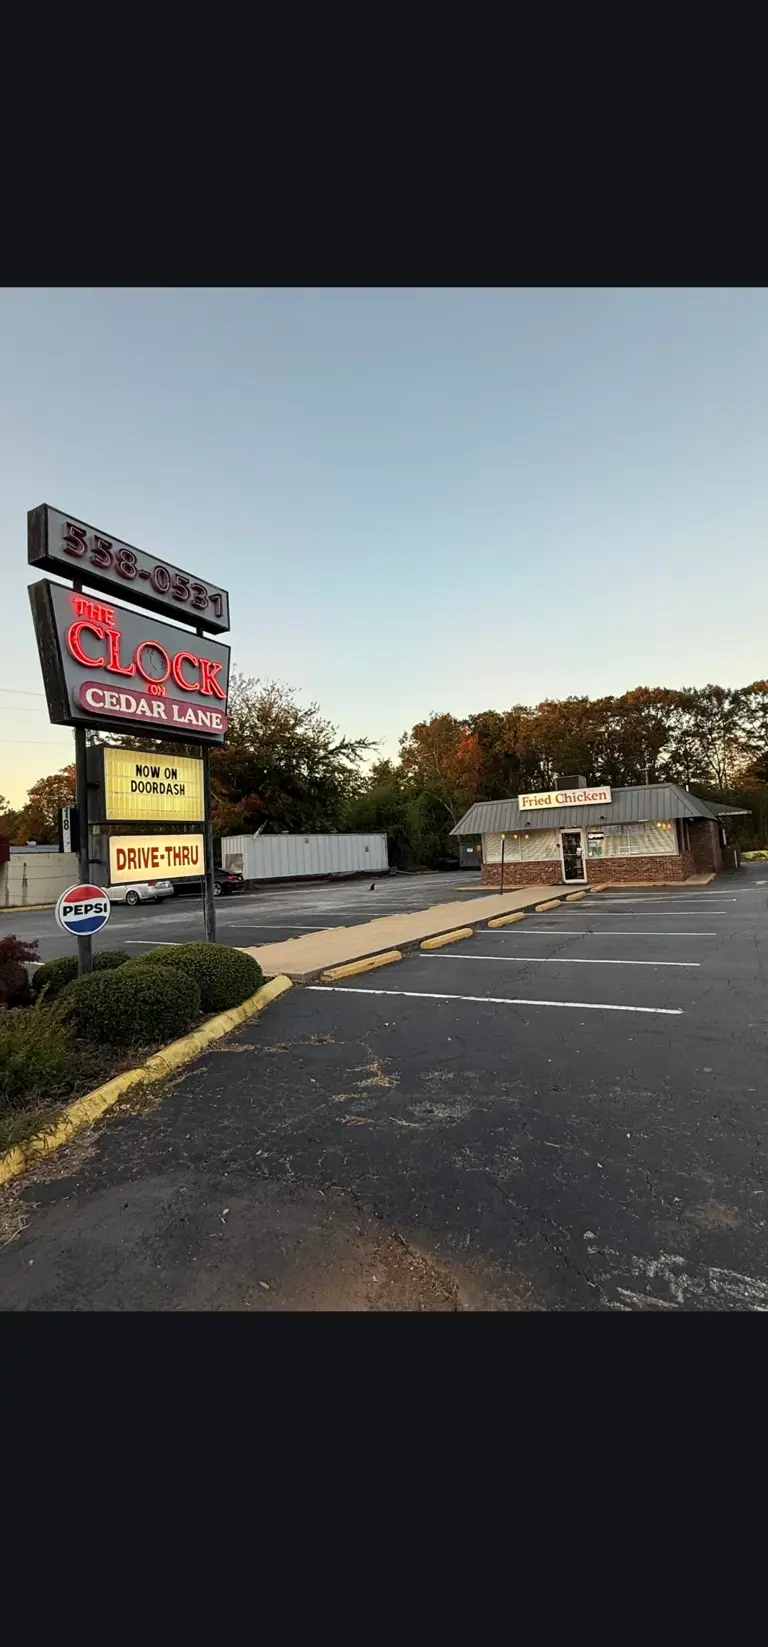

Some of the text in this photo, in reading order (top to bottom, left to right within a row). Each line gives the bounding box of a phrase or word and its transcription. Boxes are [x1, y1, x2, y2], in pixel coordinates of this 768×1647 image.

[63, 522, 224, 618] 558-0531
[72, 598, 115, 625] THE
[66, 620, 226, 699] CLOCK
[85, 687, 223, 730] CEDAR LANE
[135, 764, 178, 780] NOW ON
[130, 779, 186, 796] DOORDASH
[521, 790, 608, 808] Fried Chicken
[116, 845, 199, 871] DRIVE-THRU
[62, 902, 108, 917] PEPSI
